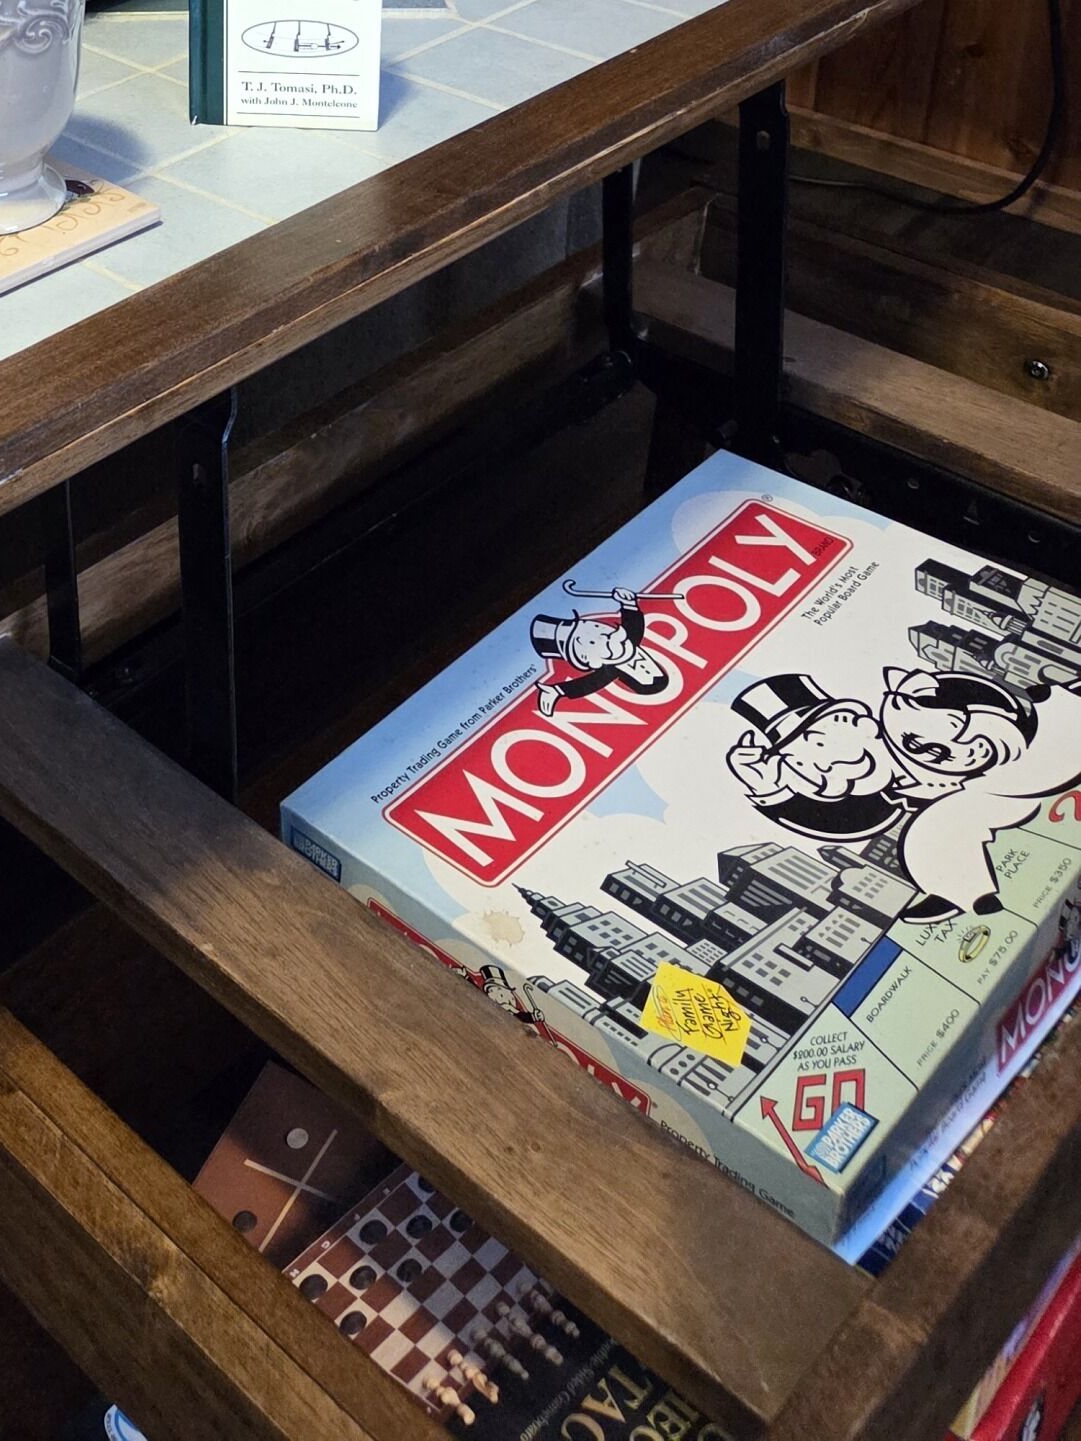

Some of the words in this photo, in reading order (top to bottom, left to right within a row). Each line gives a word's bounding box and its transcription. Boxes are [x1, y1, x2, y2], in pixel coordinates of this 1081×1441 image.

[240, 97, 261, 105] with
[264, 97, 288, 105] John
[290, 97, 300, 106] J.
[302, 98, 358, 108] Monteleone
[241, 81, 253, 92] T.
[257, 81, 267, 92] J.
[270, 82, 318, 94] Tomasi,
[322, 84, 358, 95] Ph.D.
[800, 606, 820, 620] The
[814, 582, 843, 607] World's
[839, 566, 859, 583] Most
[813, 600, 843, 626] Popular
[838, 580, 862, 601] Board
[856, 561, 880, 581] Game
[414, 513, 817, 867] MONOPOLY
[370, 771, 411, 804] Property
[406, 747, 441, 775] Trading
[436, 728, 463, 750] Game
[459, 711, 482, 730] from
[478, 692, 506, 714] Parker
[995, 848, 1018, 872] PARK
[1003, 850, 1030, 880] PLACE
[1049, 857, 1072, 884] $350
[915, 922, 939, 947] LUX
[934, 920, 958, 944] TAX
[977, 967, 991, 985] PAY
[989, 930, 1019, 967] $75.00
[865, 965, 912, 1023] BOARDWALK
[672, 987, 700, 1035] Family
[694, 993, 723, 1039] Game
[936, 1008, 960, 1039] $400
[792, 1047, 828, 1061] $200.00
[830, 1040, 866, 1056] SALARY
[810, 1031, 848, 1046] COLLECT
[797, 1060, 810, 1072] AS
[812, 1058, 831, 1071] YOU
[833, 1054, 857, 1067] PASS
[792, 1068, 866, 1132] GO
[820, 1105, 857, 1147] PARKER
